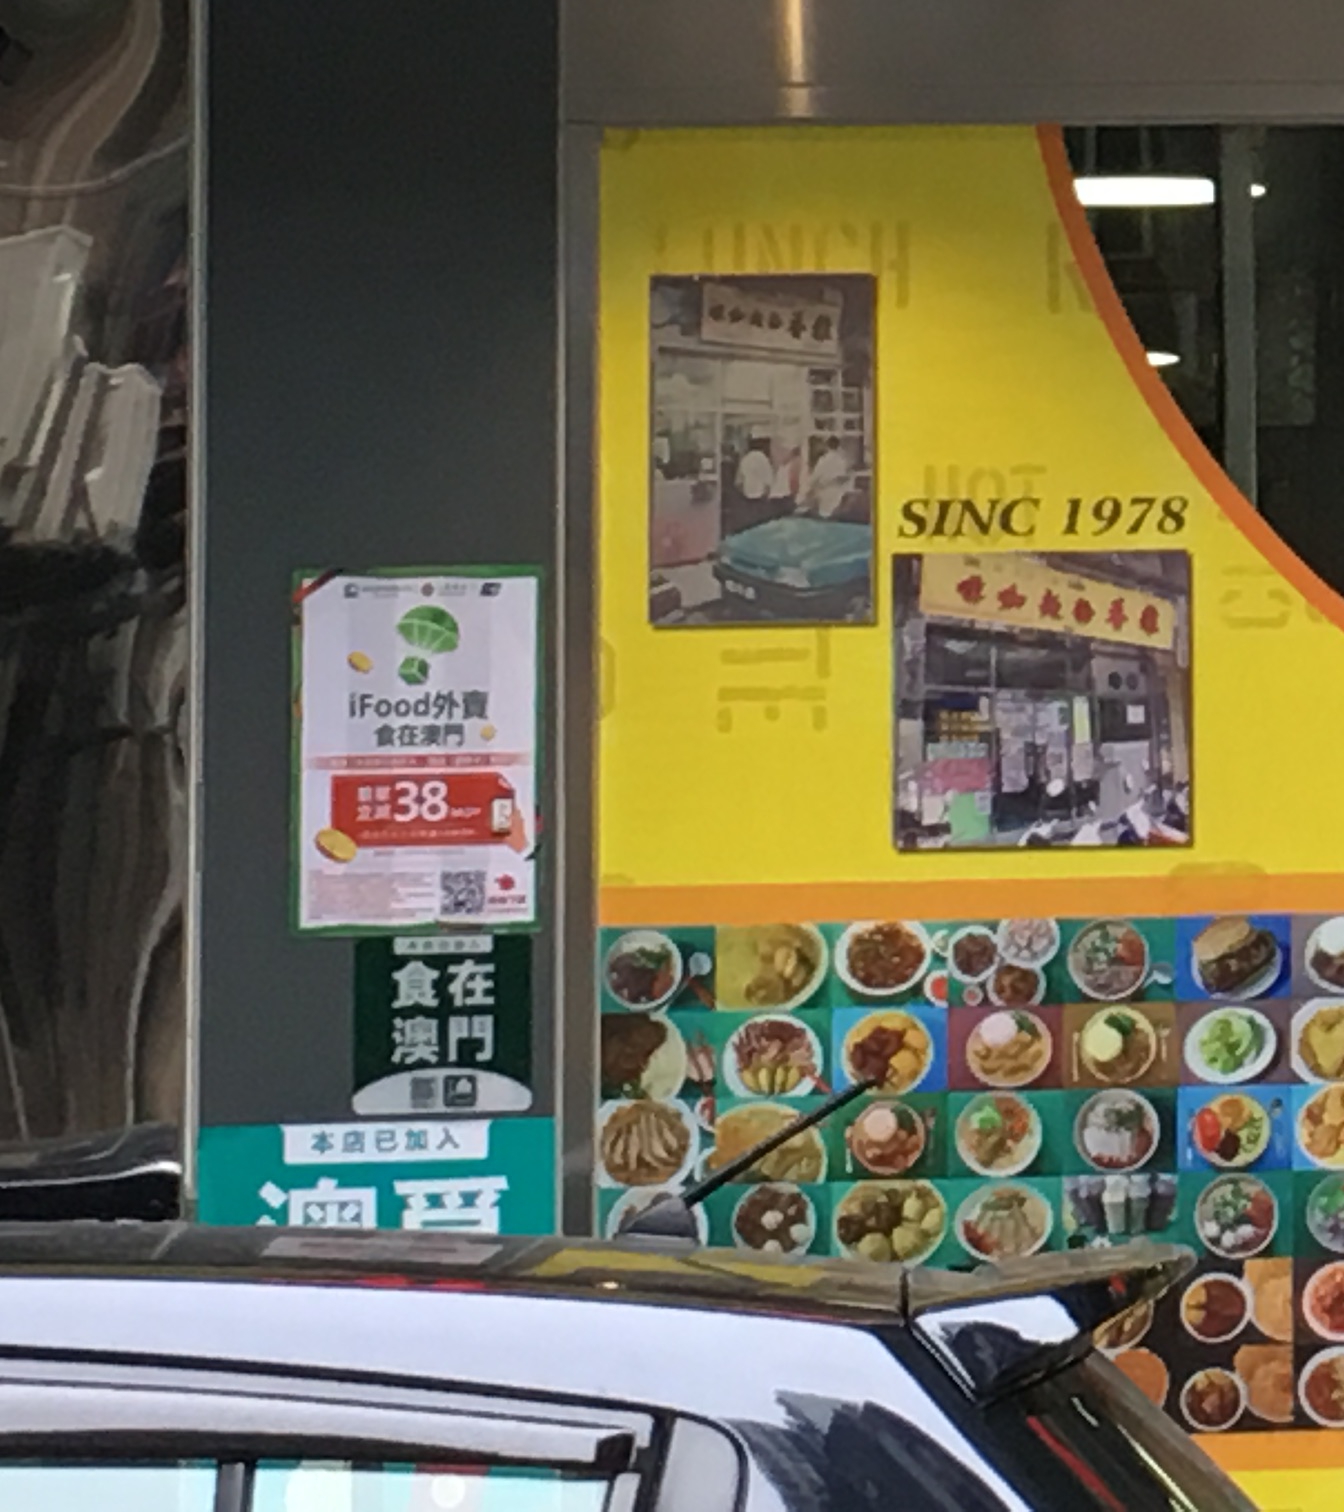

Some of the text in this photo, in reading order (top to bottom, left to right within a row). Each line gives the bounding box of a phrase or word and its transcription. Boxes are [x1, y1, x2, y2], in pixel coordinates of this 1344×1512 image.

[897, 495, 1190, 539] SINC 1978
[393, 780, 449, 822] 38
[310, 1128, 461, 1155] 本店已加入
